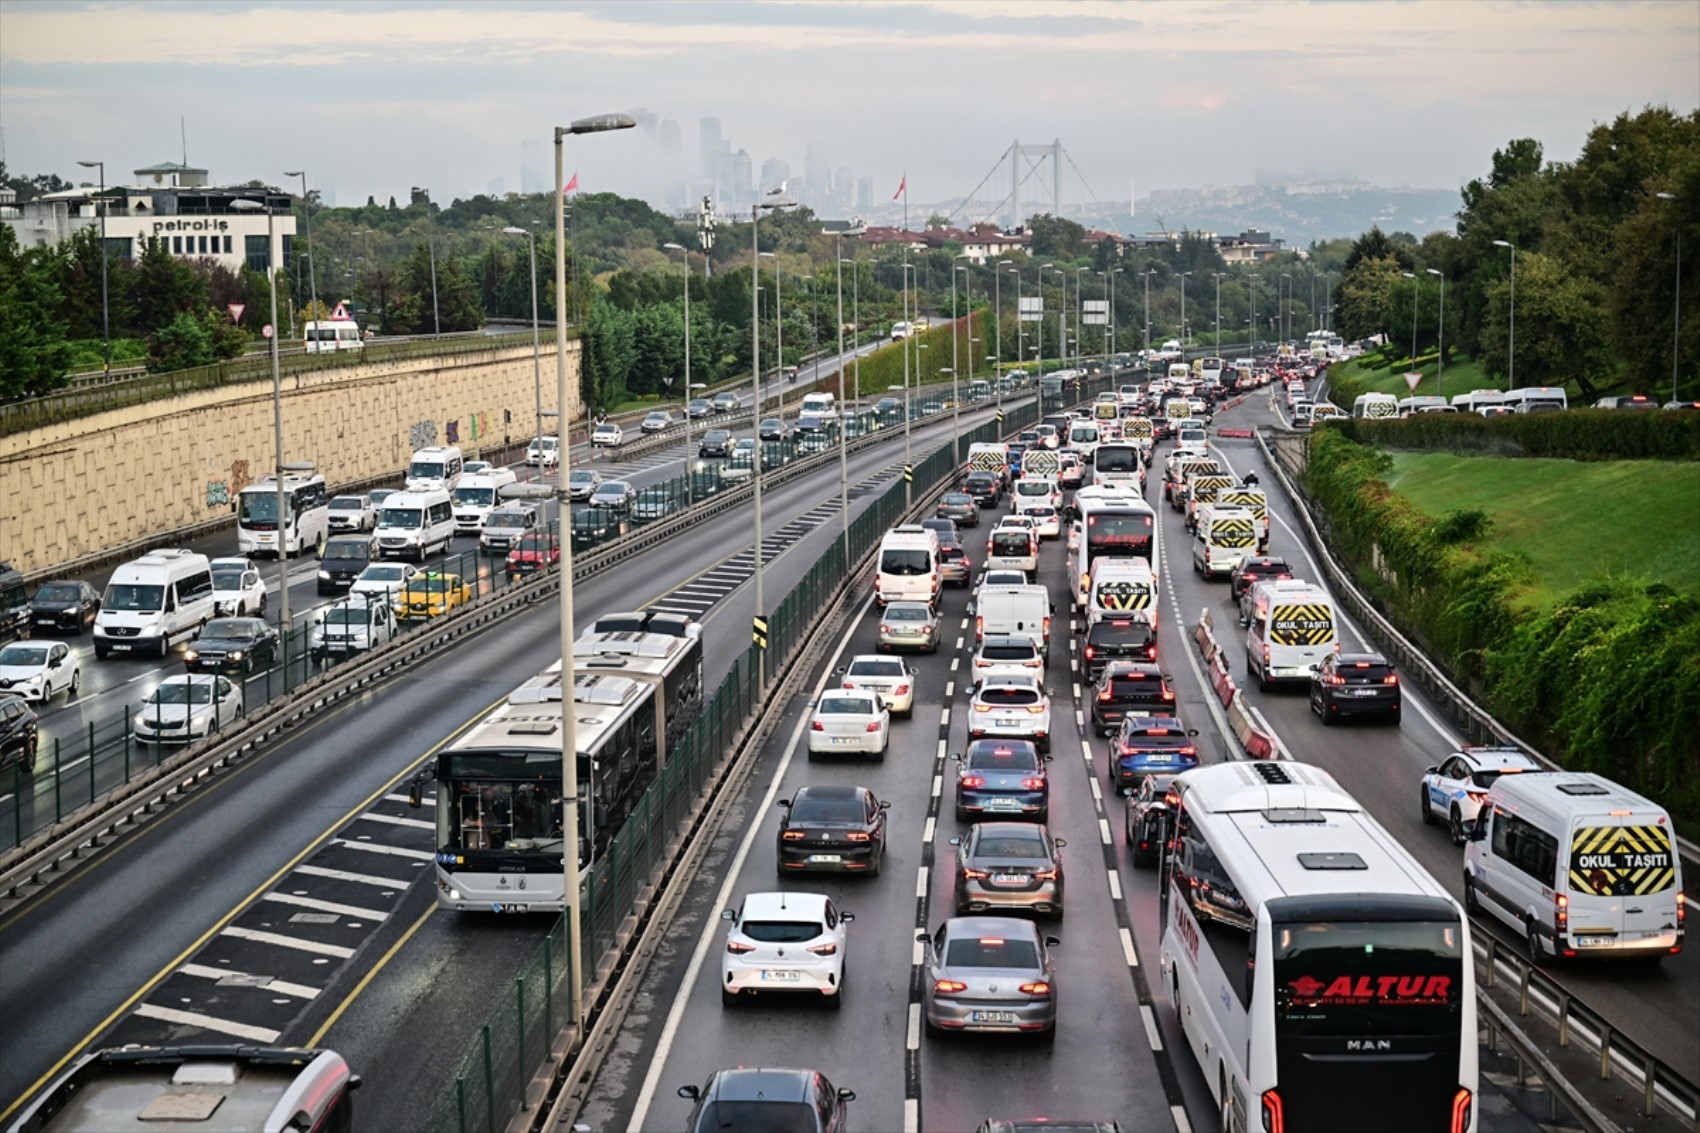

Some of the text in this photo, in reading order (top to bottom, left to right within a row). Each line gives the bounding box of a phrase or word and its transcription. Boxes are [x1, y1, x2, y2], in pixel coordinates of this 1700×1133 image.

[1276, 620, 1330, 631] OKUL TAŞITI
[1579, 853, 1668, 869] OKUL TAŞITI
[1322, 976, 1451, 997] ALTUR
[1347, 1041, 1391, 1050] MAN
